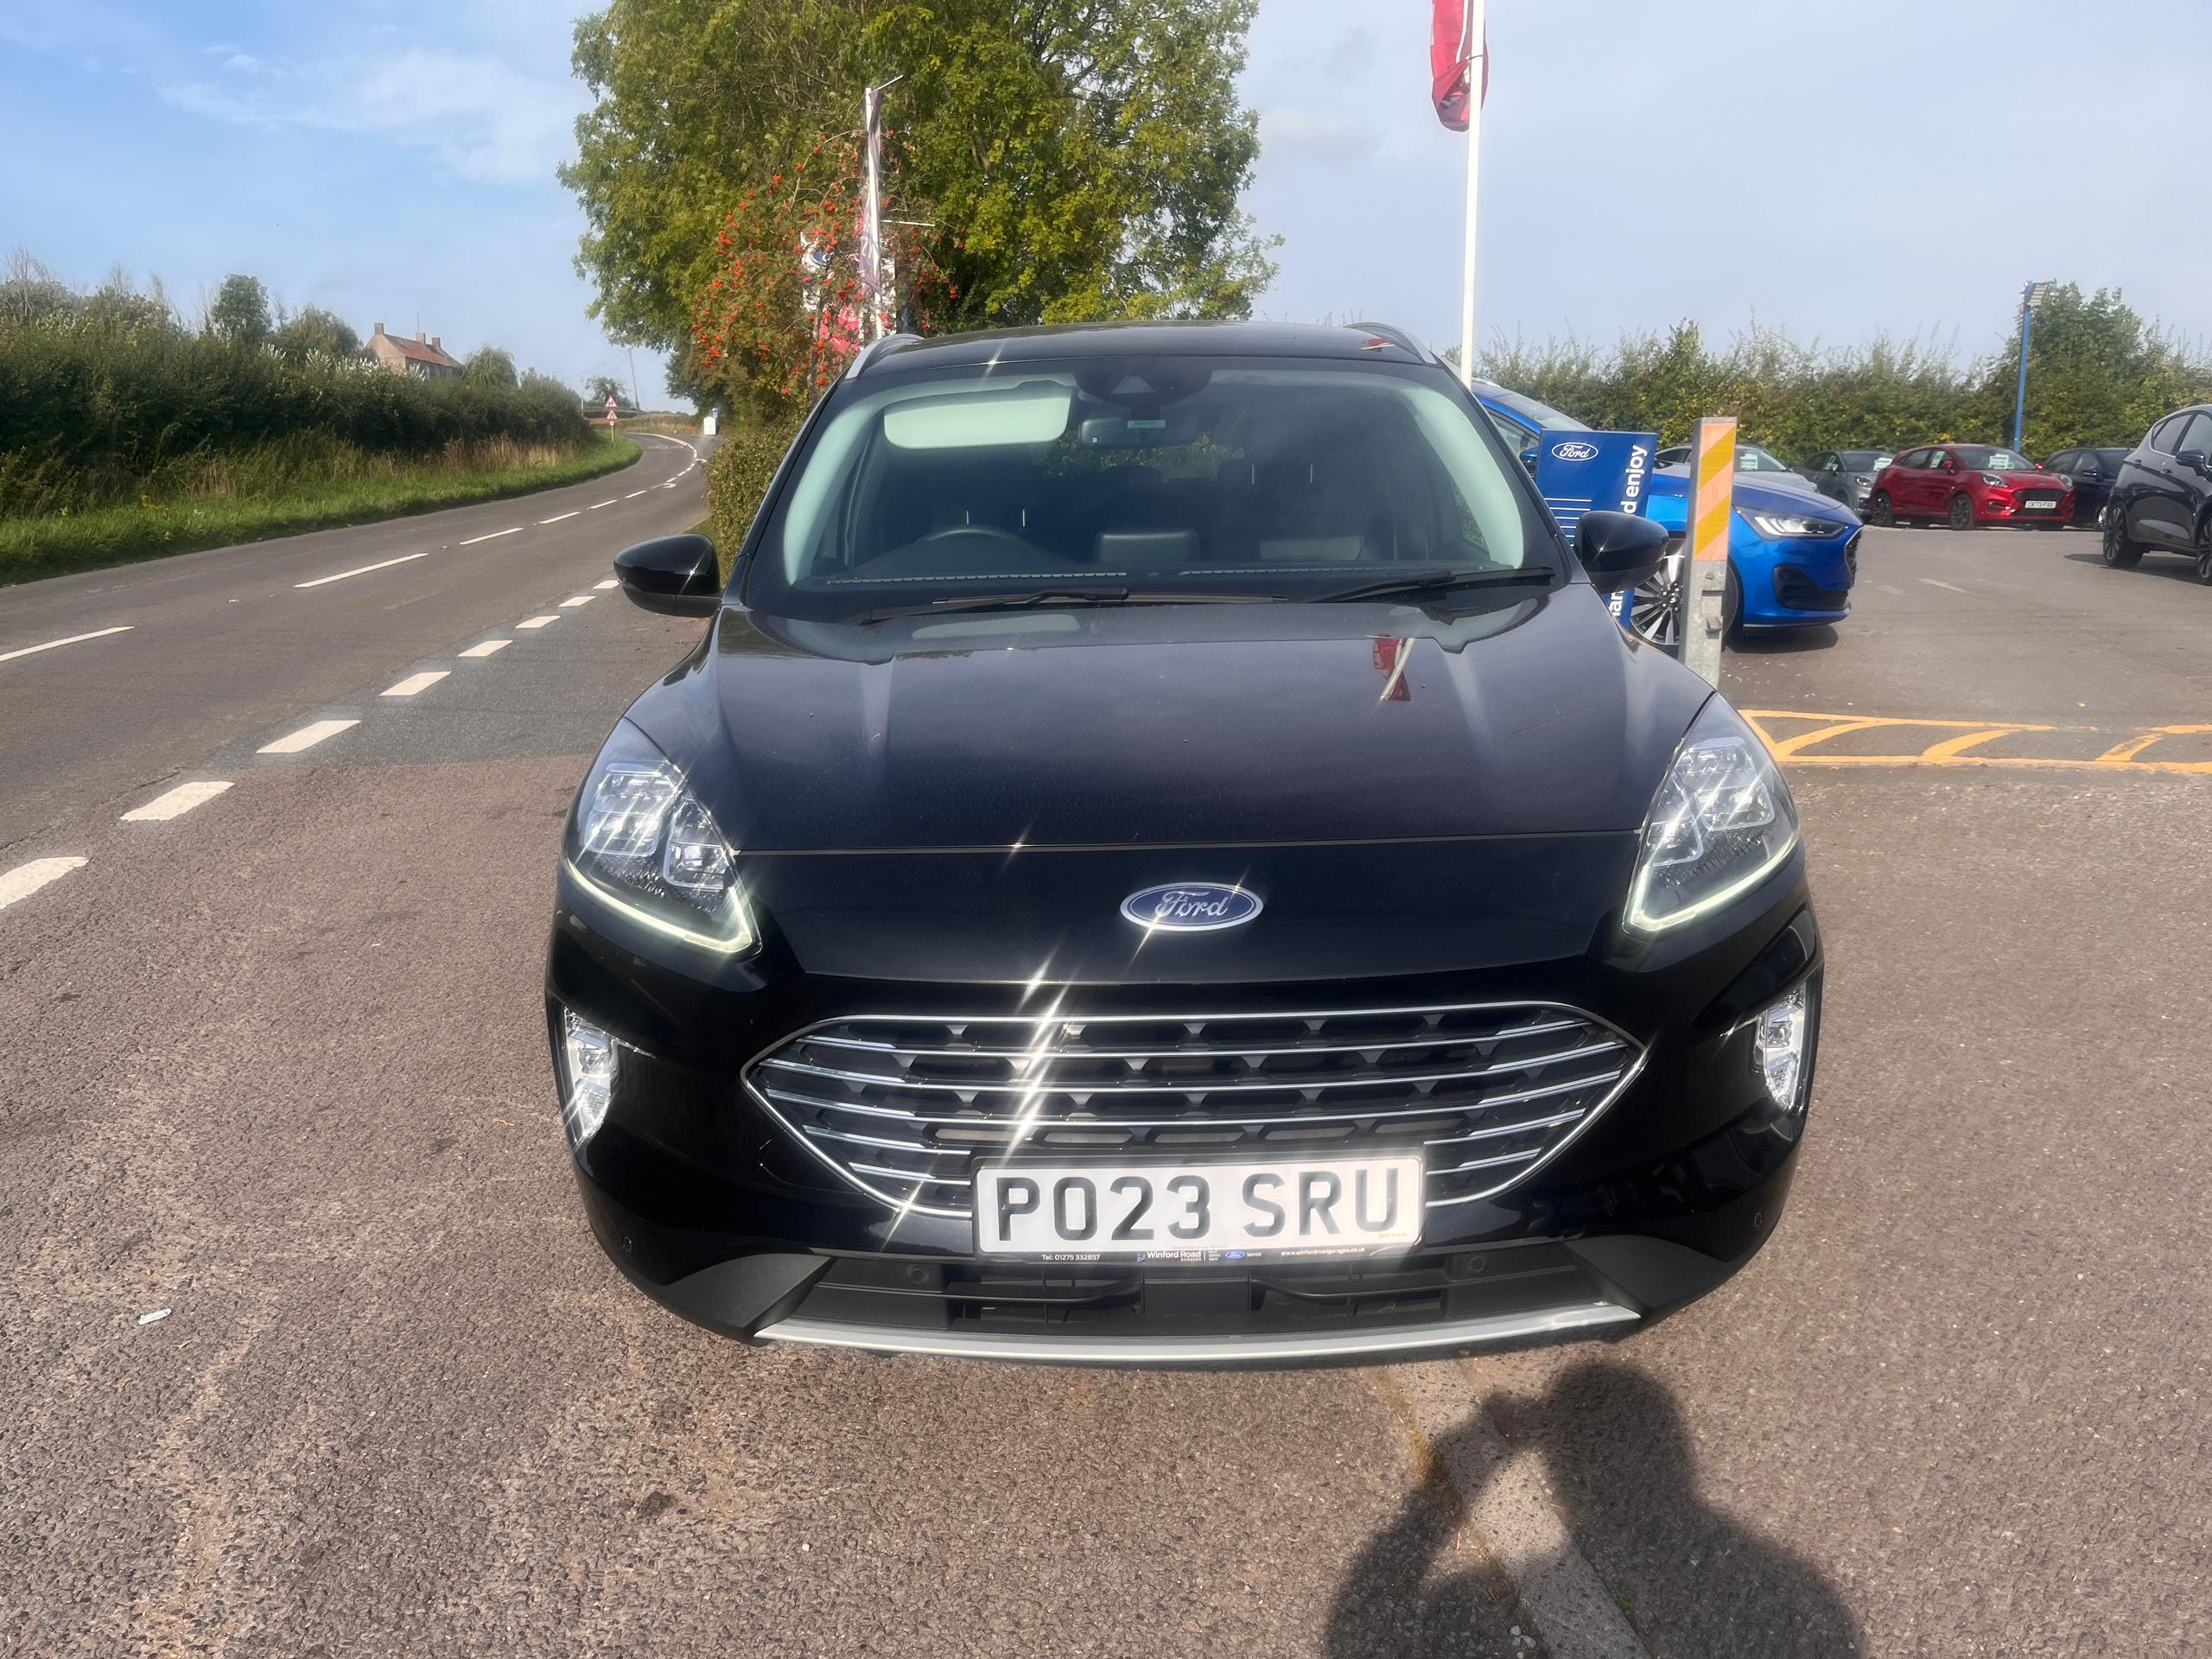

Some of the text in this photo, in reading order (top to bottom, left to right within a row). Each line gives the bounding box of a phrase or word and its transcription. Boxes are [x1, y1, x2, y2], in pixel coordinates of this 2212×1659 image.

[1559, 444, 1591, 458] Ford
[1625, 444, 1648, 498] enjoy
[1154, 891, 1229, 918] Ford
[995, 1167, 1399, 1242] PO23 SRU
[1147, 1250, 1179, 1259] Winford
